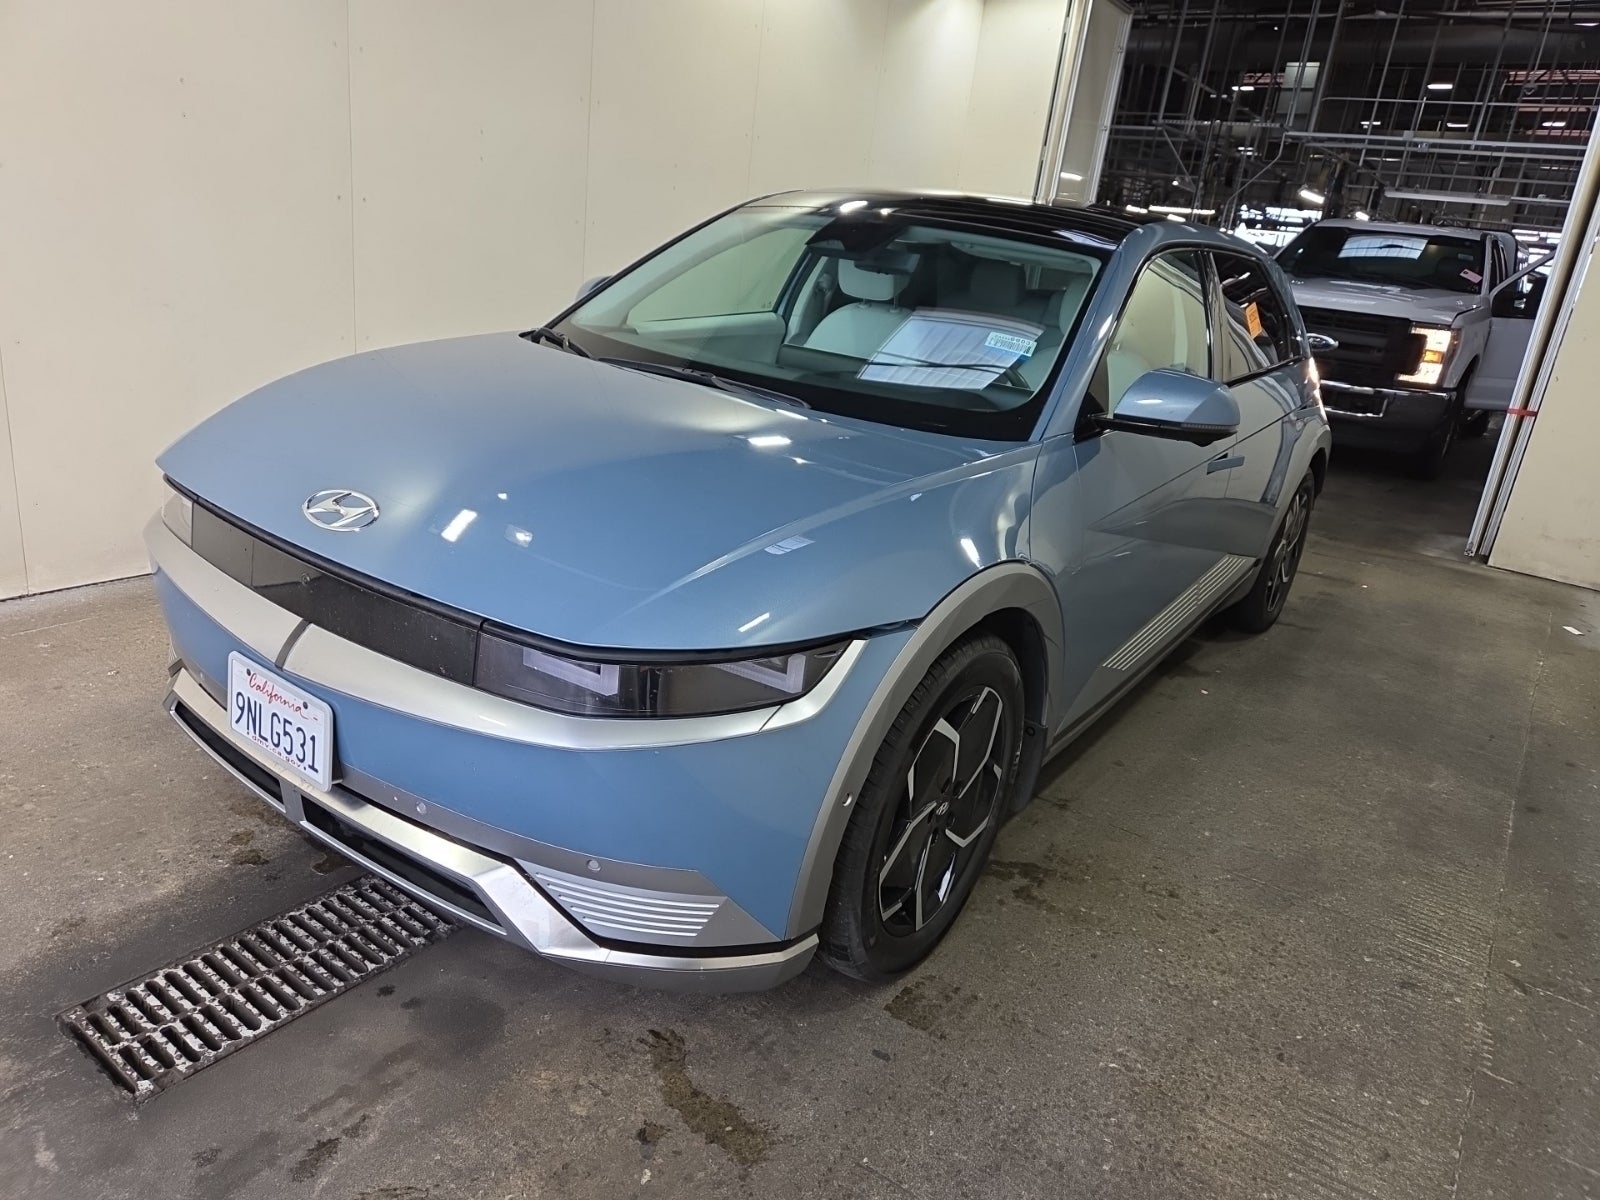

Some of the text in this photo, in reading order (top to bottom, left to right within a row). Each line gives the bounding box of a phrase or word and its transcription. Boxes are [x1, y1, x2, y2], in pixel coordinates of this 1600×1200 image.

[249, 672, 309, 719] California
[234, 691, 319, 774] 9NLG531
[251, 735, 301, 767] dmv.ca.gov
